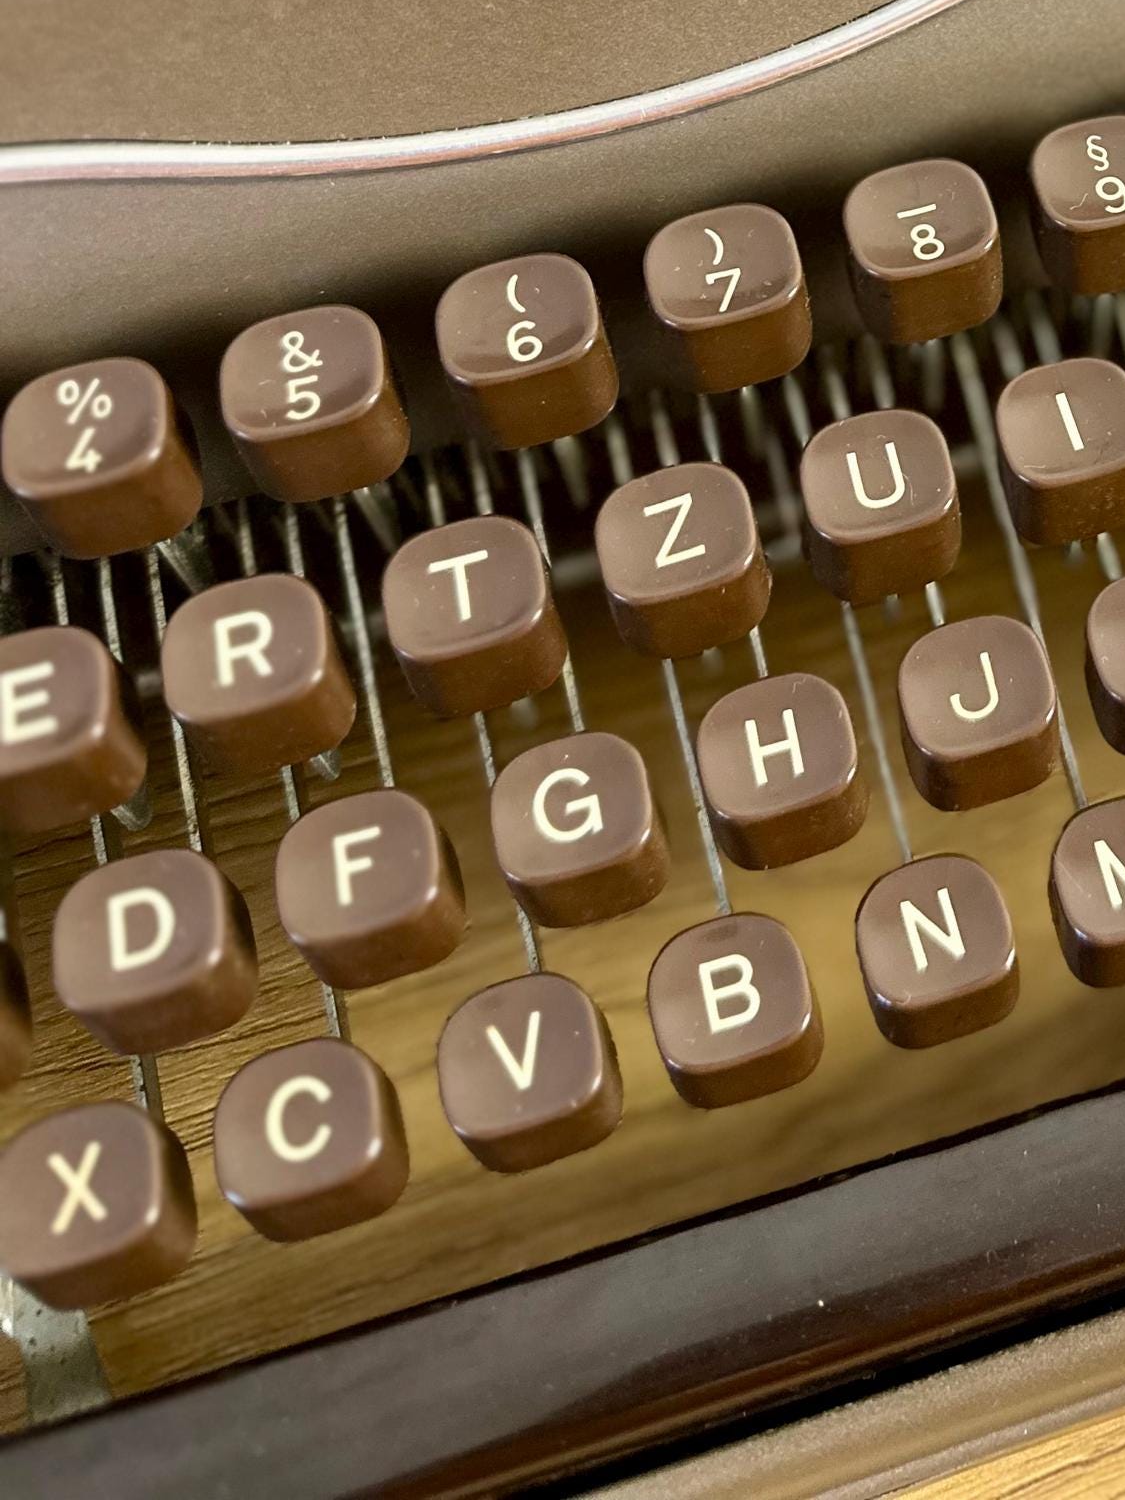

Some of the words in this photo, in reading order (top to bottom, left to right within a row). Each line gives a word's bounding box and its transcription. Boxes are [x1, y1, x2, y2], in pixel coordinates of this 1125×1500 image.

[1086, 134, 1110, 172] §
[704, 228, 724, 266] )
[910, 223, 945, 261] 8
[506, 274, 526, 313] (
[705, 267, 741, 313] 7
[279, 330, 324, 373] &
[506, 320, 543, 362] 6
[56, 377, 113, 426] %
[285, 375, 321, 421] 5
[1055, 392, 1085, 451] I
[65, 443, 103, 474] 4
[845, 441, 906, 509] U
[643, 492, 706, 569] Z
[427, 549, 489, 622] T
[213, 611, 273, 687] R
[0, 662, 57, 745] E
[949, 651, 999, 723] J
[744, 708, 805, 788] H
[532, 767, 604, 843] G
[332, 826, 381, 906] F
[107, 888, 175, 972] D
[900, 887, 966, 972] N
[698, 953, 761, 1035] B
[486, 1010, 541, 1090] V
[265, 1076, 332, 1162] C
[47, 1141, 107, 1235] X
